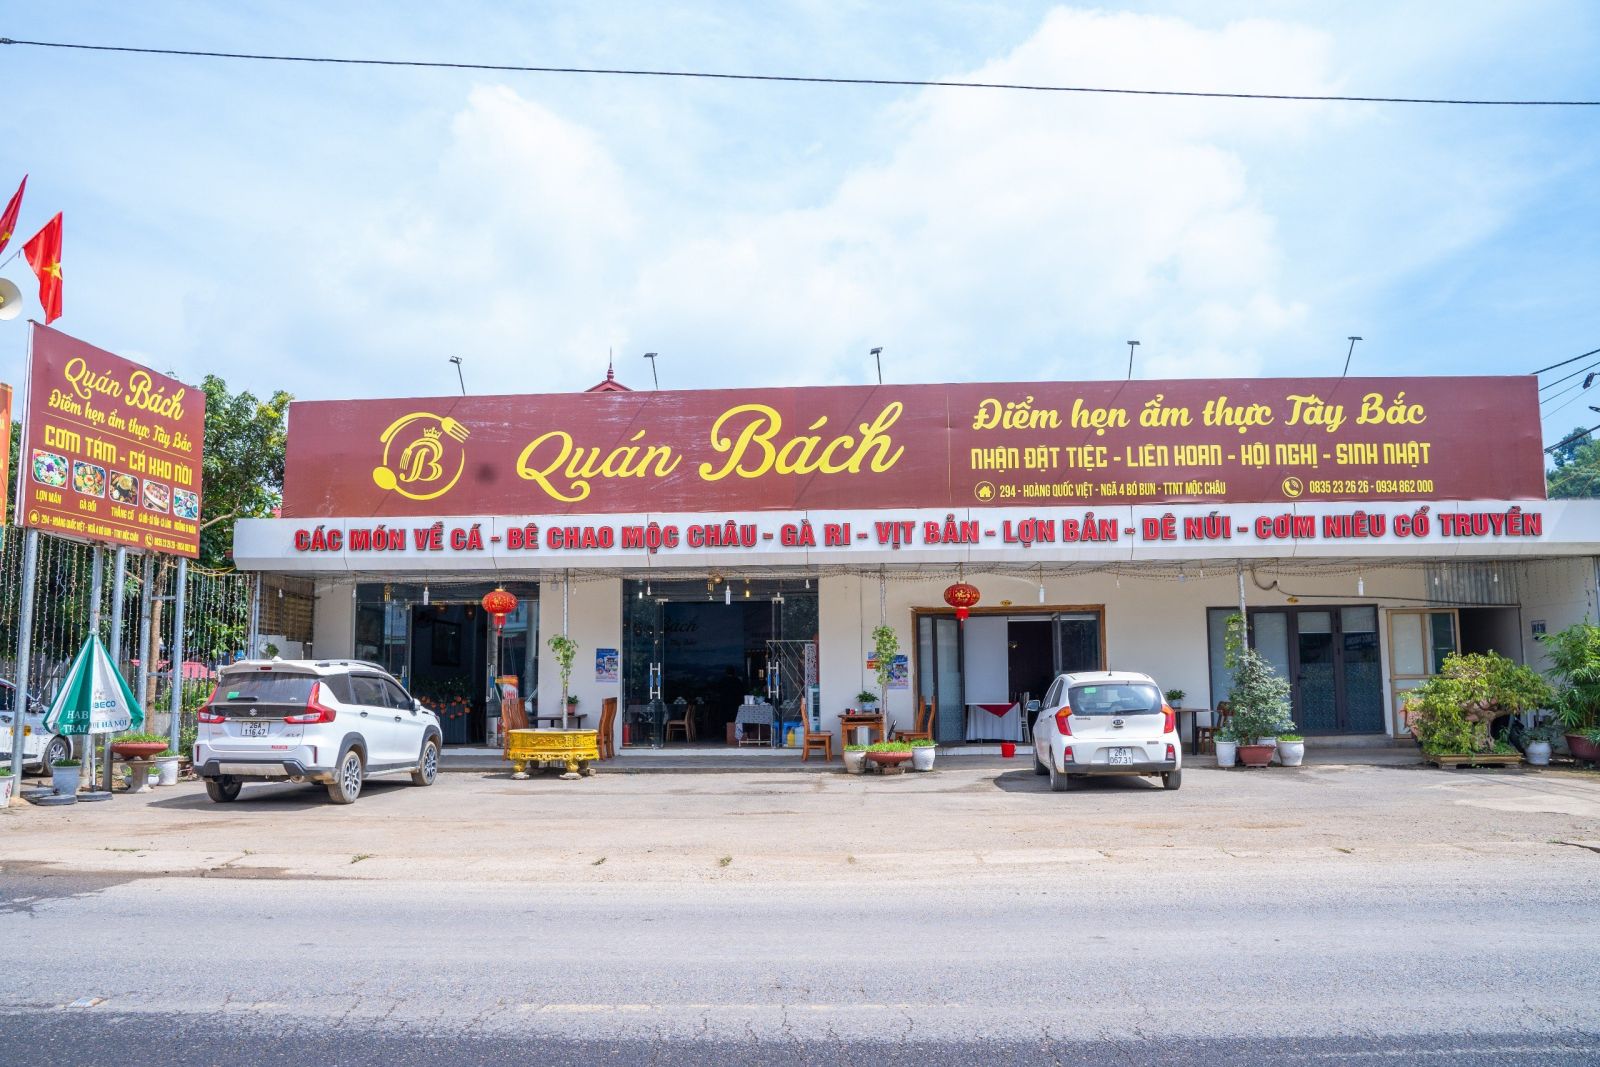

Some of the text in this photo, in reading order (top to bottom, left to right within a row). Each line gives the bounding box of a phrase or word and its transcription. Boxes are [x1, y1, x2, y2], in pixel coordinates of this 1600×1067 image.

[64, 357, 185, 420] Quán Bách
[48, 388, 192, 452] Điểm hẹn ẩm thực Tây Bắc
[972, 391, 1425, 437] Điểm hẹn ẩm thực Tây Bắc
[44, 425, 81, 454] CƠM
[85, 436, 117, 464] TÁM
[129, 450, 146, 472] CÁ
[149, 456, 172, 480] KHO
[174, 461, 193, 486] NỒI
[516, 400, 905, 503] Quán Bách
[971, 446, 1020, 473] NHẬN
[1023, 445, 1060, 472] ĐẶT
[1066, 445, 1108, 472] TIỆC
[1126, 444, 1169, 467] LIÊN
[1174, 444, 1223, 467] HOAN
[1240, 442, 1270, 470] HỘI
[1275, 443, 1318, 469] NGHỊ
[1336, 443, 1379, 465] SINH
[1383, 441, 1430, 468] NHẬT
[999, 484, 1016, 498] 294
[1023, 483, 1051, 498] HOÀNG
[1053, 480, 1074, 497] QUỐC
[1075, 482, 1093, 499] VIỆT
[1100, 481, 1117, 496] NGÃ
[1118, 484, 1126, 496] 4
[1126, 481, 1137, 496] BÓ
[1139, 483, 1156, 495] BUN
[1163, 482, 1183, 495] TTNT
[1185, 480, 1203, 497] MỘC
[1204, 479, 1226, 495] CHÂU
[1309, 480, 1331, 494] 0835
[1332, 480, 1343, 493] 23
[1345, 480, 1356, 493] 26
[1358, 480, 1369, 493] 26
[1376, 480, 1398, 493] 0934
[1399, 480, 1415, 493] 862
[1417, 479, 1433, 493] 000
[294, 524, 344, 551] CÁC
[349, 523, 406, 550] MÓN
[450, 523, 484, 550] CÁ
[507, 523, 540, 550] BÊ
[546, 525, 614, 549] CHAO
[622, 521, 679, 553] MỘC
[687, 519, 757, 548] CHÂU
[780, 519, 816, 546] GÀ
[824, 522, 851, 546] RI
[875, 521, 915, 550] VỊT
[924, 513, 980, 544] BẢN
[1003, 517, 1055, 547] LỢN
[1063, 512, 1119, 542] BẢN
[1143, 513, 1178, 540] DÊ
[1184, 511, 1232, 539] NÚI
[1255, 513, 1316, 540] CƠM
[1324, 510, 1387, 539] NIÊU
[1394, 505, 1430, 537] CỔ
[1439, 505, 1543, 537] TRUYỀN
[92, 700, 116, 709] BECO
[249, 721, 262, 729] 26A
[1114, 749, 1127, 757] 26A
